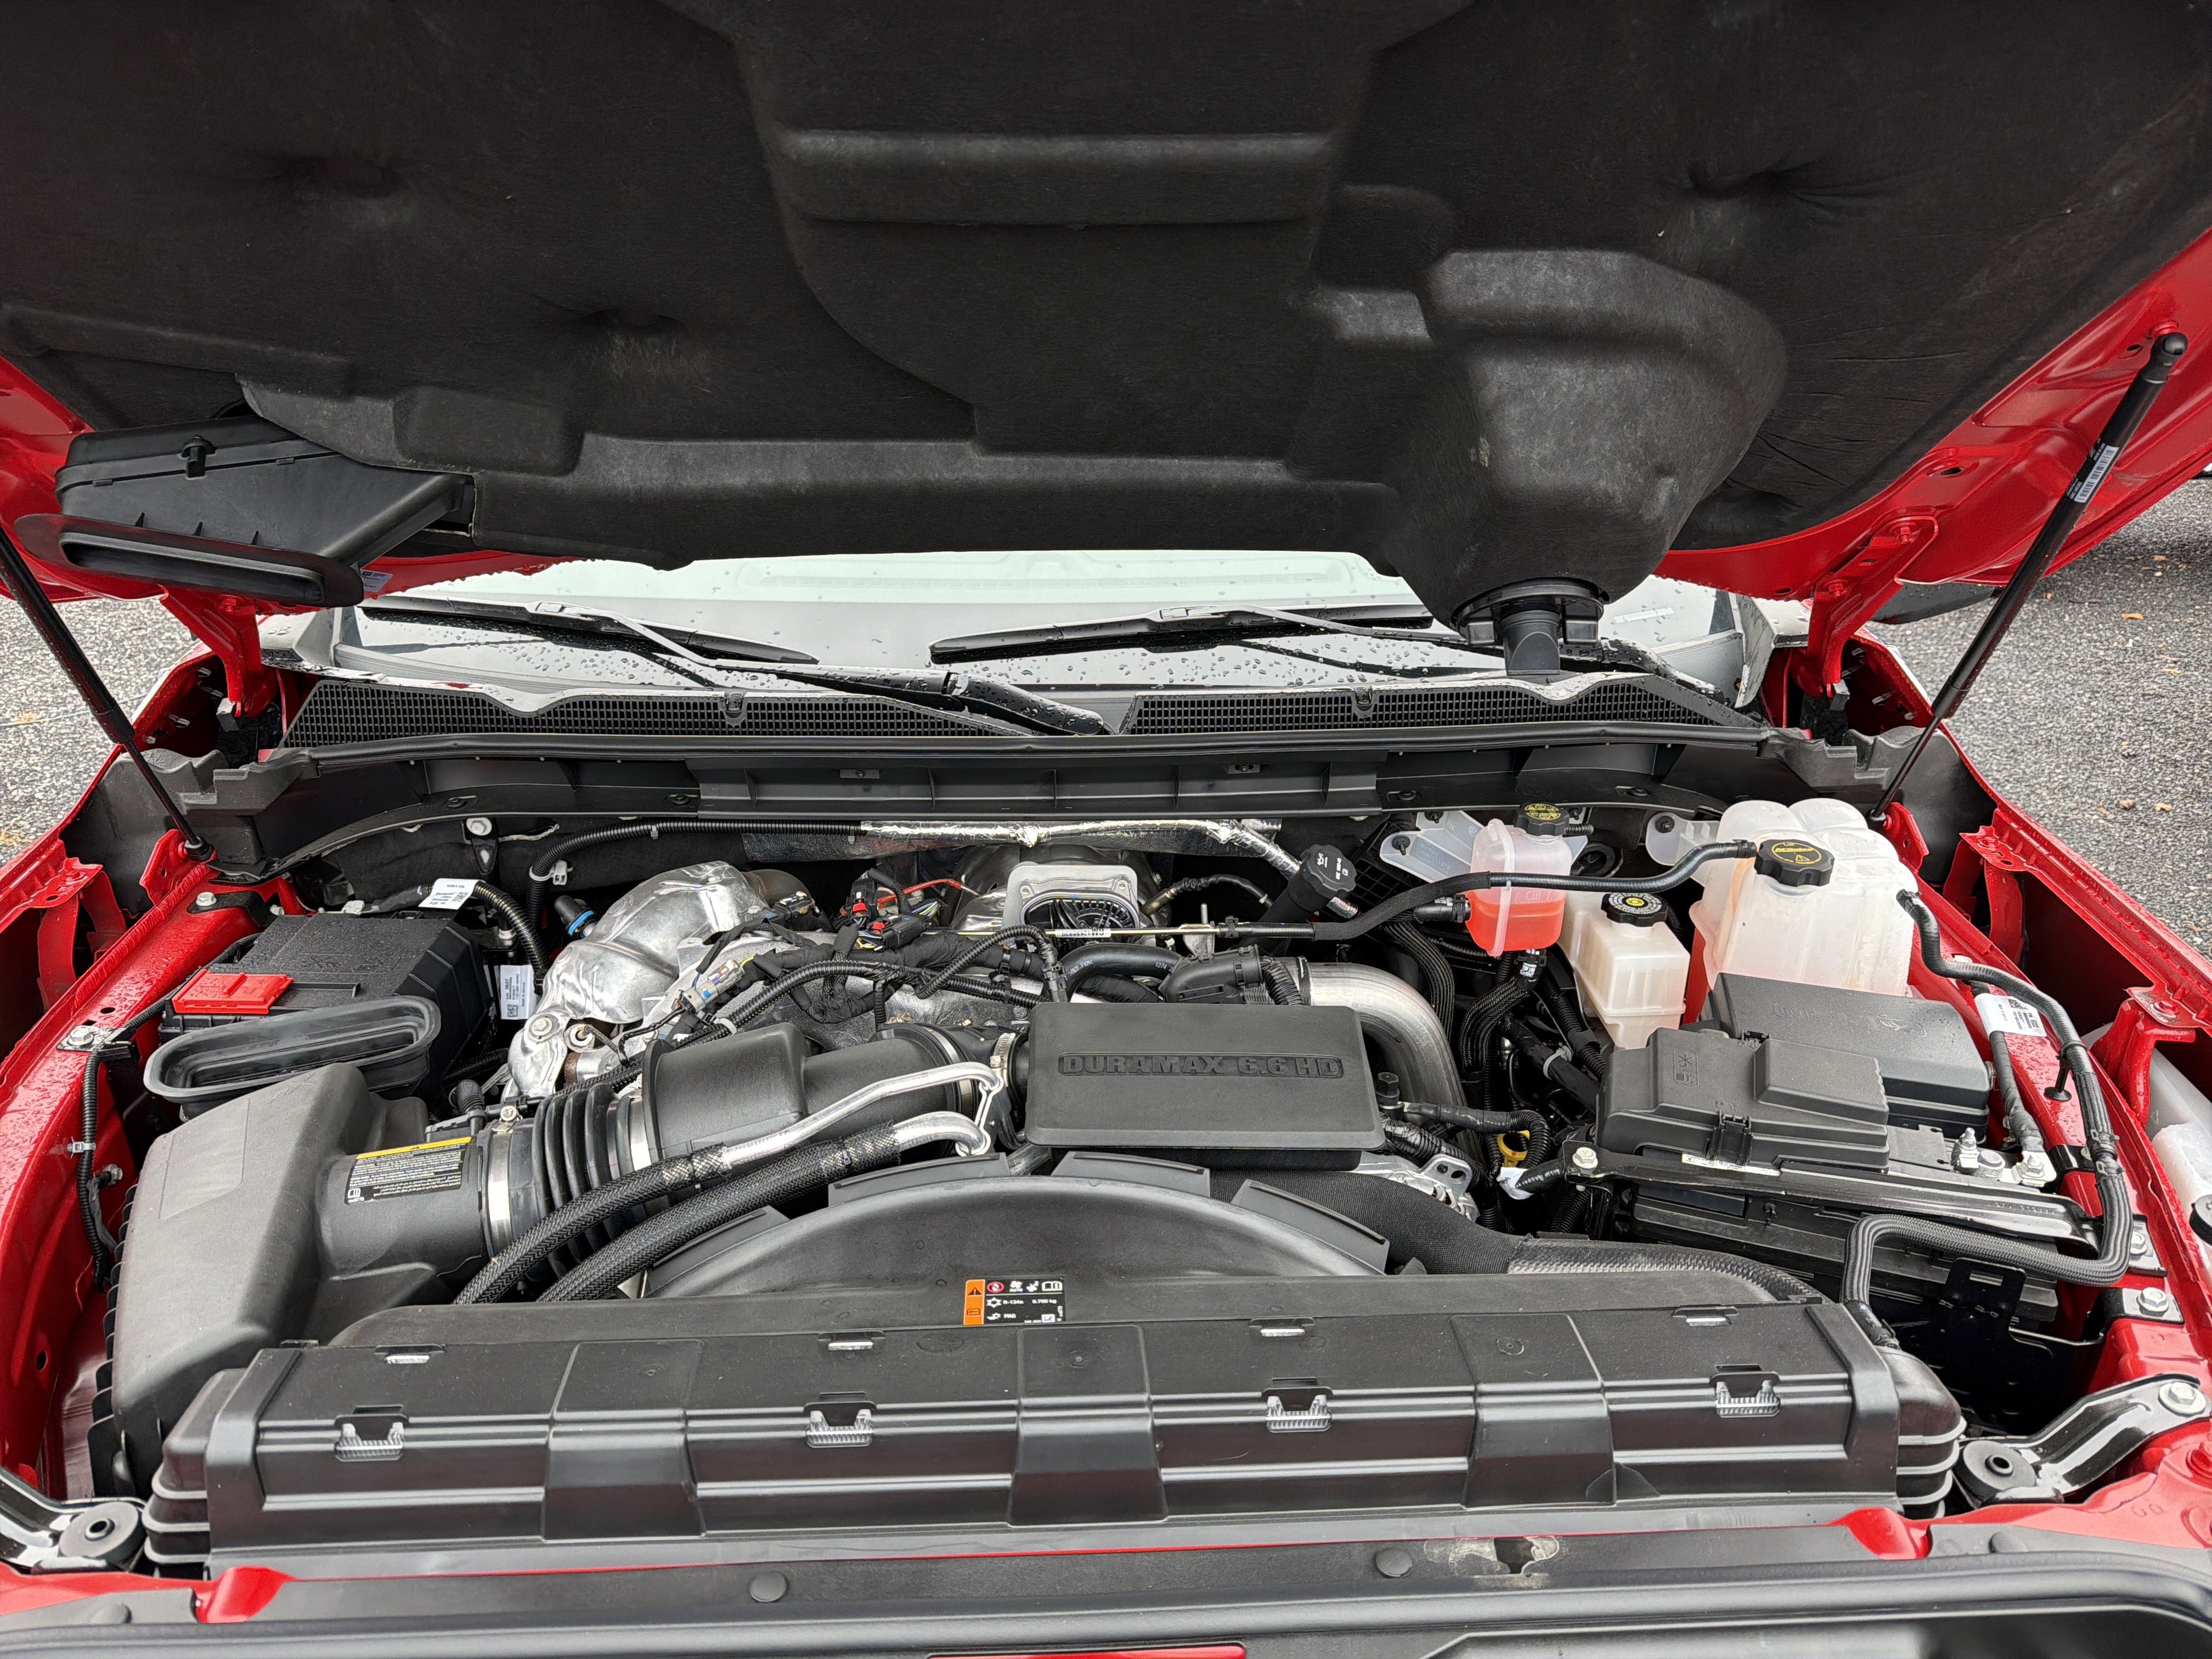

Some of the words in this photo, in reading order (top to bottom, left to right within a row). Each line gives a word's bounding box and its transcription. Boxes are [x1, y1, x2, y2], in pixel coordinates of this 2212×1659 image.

[1063, 1055, 1224, 1075] DURAMAX
[1237, 1056, 1288, 1075] 6.6
[1295, 1057, 1340, 1077] HD
